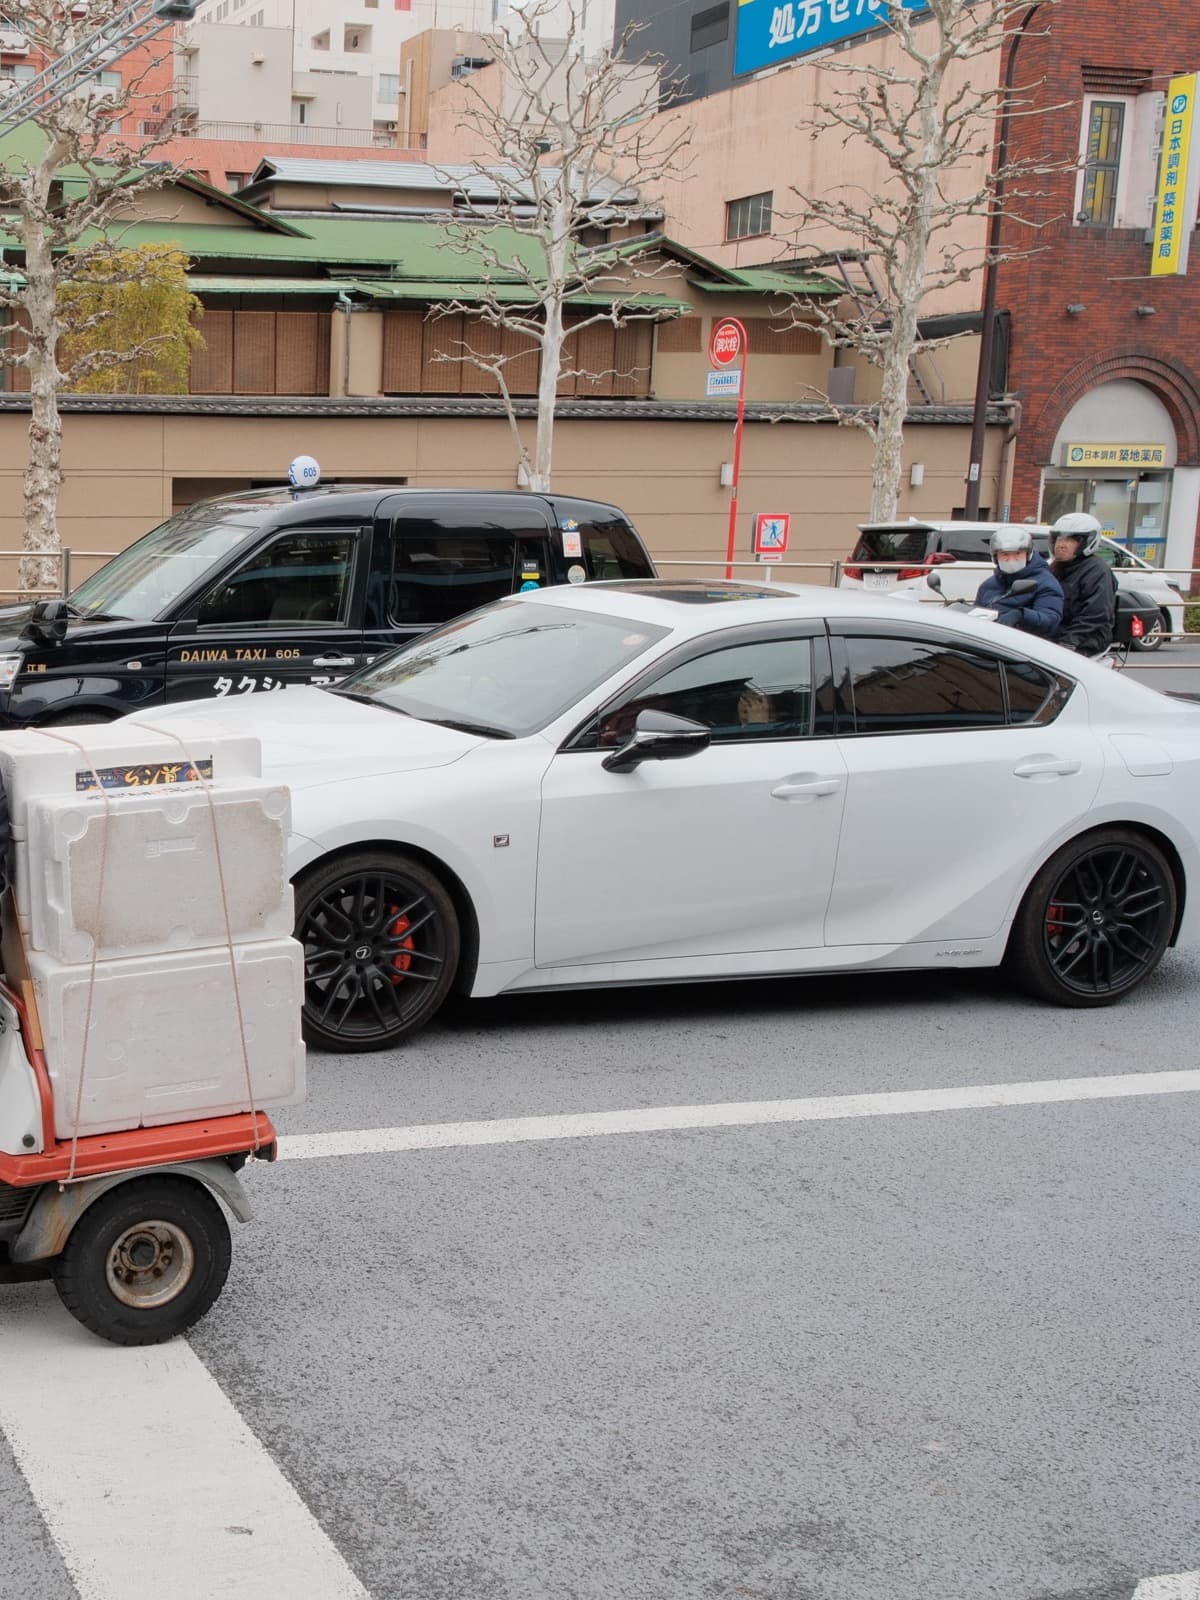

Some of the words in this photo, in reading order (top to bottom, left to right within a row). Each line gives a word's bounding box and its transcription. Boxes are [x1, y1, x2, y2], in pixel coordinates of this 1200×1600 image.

[1165, 119, 1183, 186] 日本調剤
[1158, 191, 1177, 259] 築地薬局
[1084, 450, 1117, 461] 日本調剤
[1118, 448, 1163, 462] 築地薬局
[303, 467, 318, 478] 605
[180, 650, 229, 662] DAIWA
[235, 649, 267, 661] TAXI
[275, 649, 300, 659] 605
